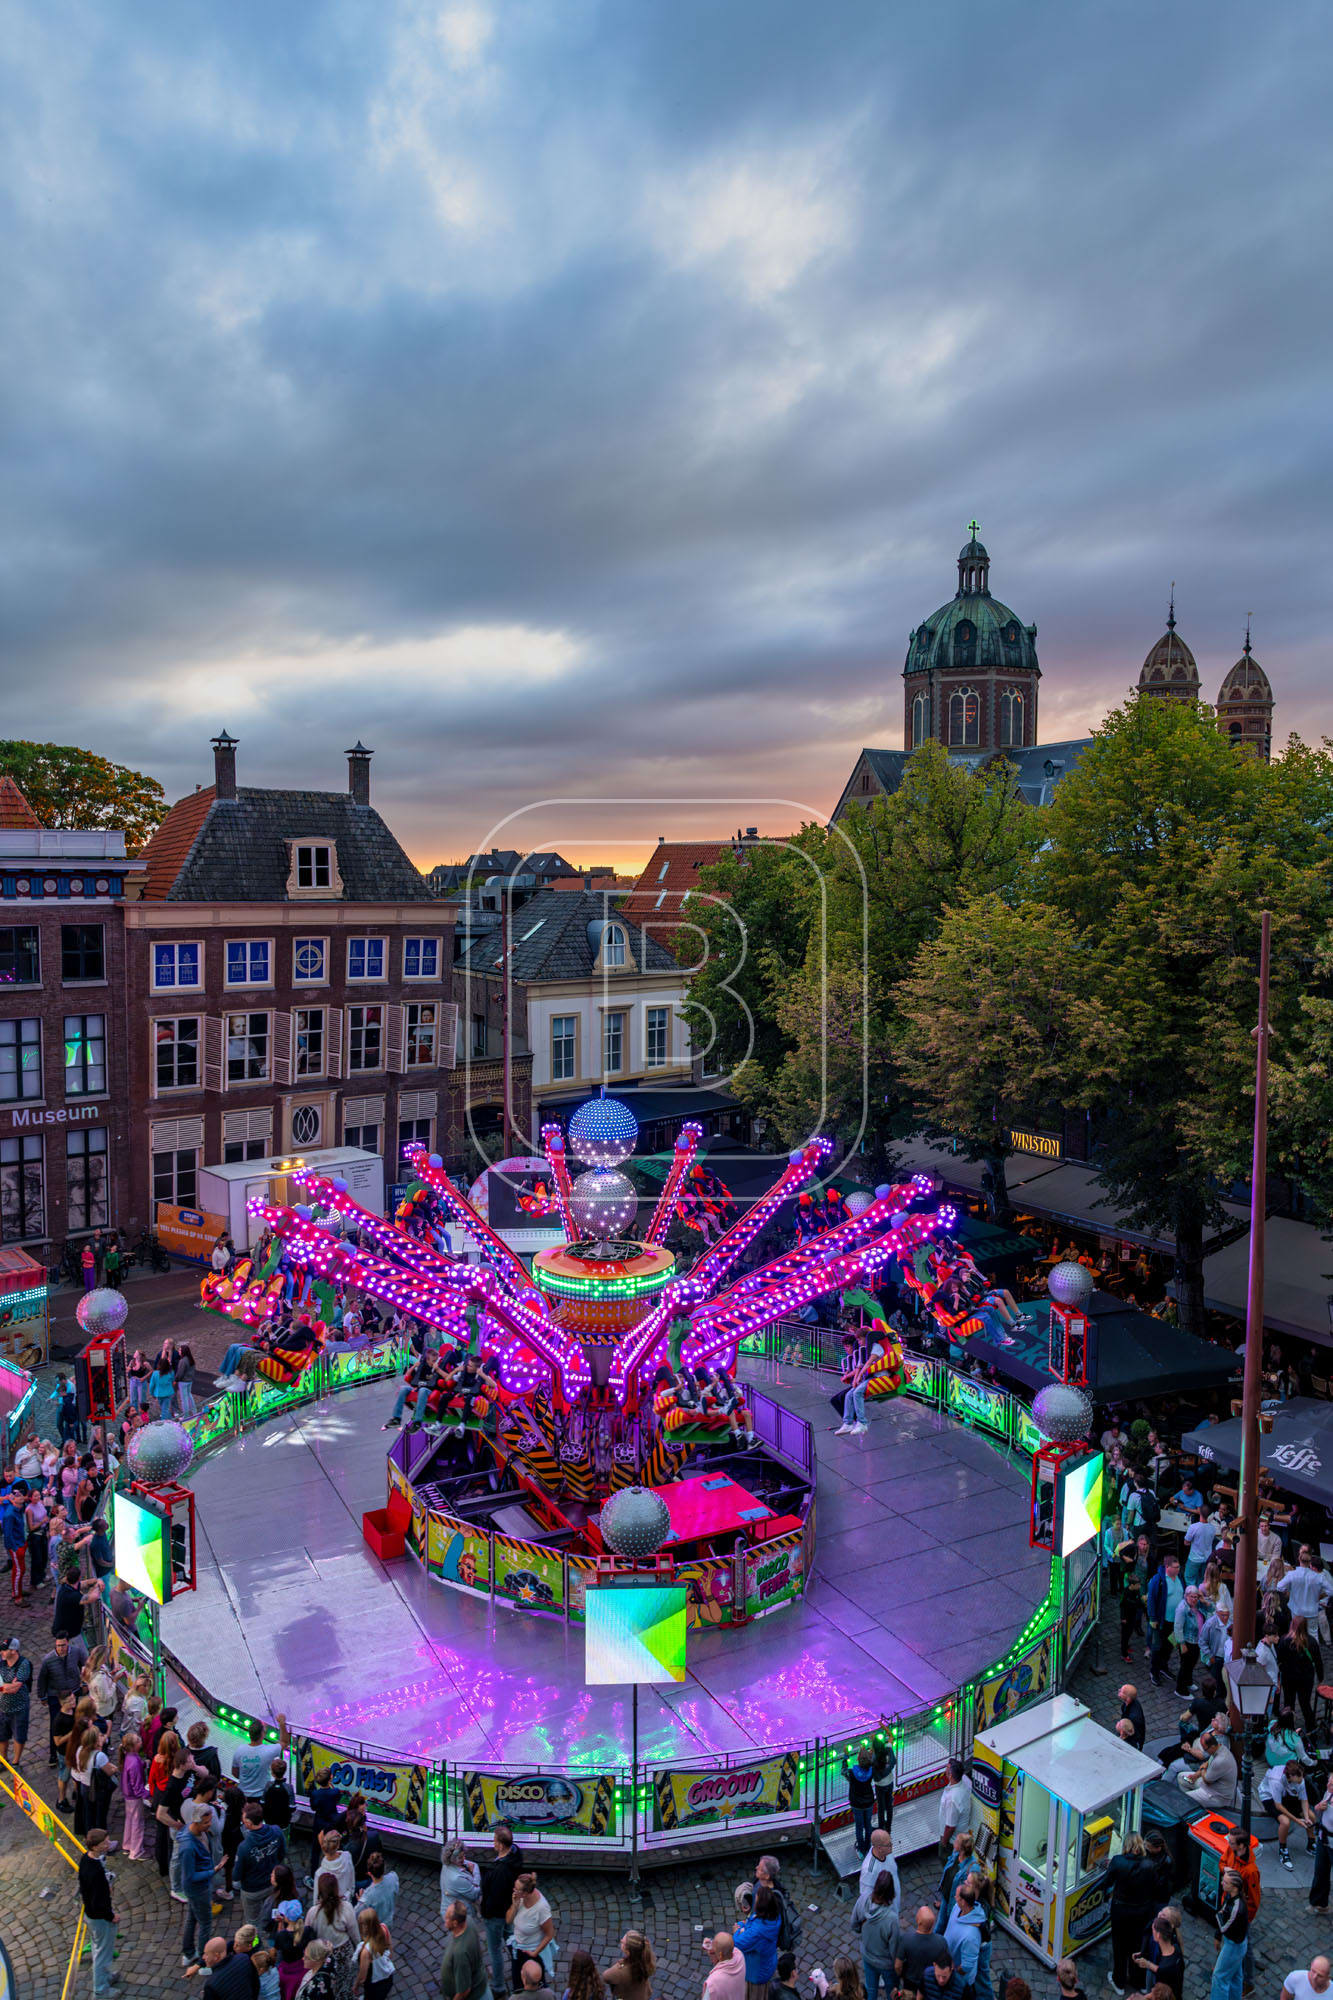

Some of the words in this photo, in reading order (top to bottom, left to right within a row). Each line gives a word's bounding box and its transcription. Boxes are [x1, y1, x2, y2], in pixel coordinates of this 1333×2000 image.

[12, 1105, 99, 1127] Museum
[1010, 1130, 1060, 1157] WINSTON
[1198, 1445, 1215, 1460] Leffe
[1267, 1444, 1322, 1470] Leffe
[331, 1763, 354, 1787] GO
[356, 1767, 396, 1793] FAST
[687, 1771, 762, 1805] GROOVY
[974, 1779, 997, 1800] RIDE
[497, 1785, 544, 1800] DISCO
[1025, 1882, 1041, 1898] ZONE
[1071, 1890, 1103, 1922] DISCO
